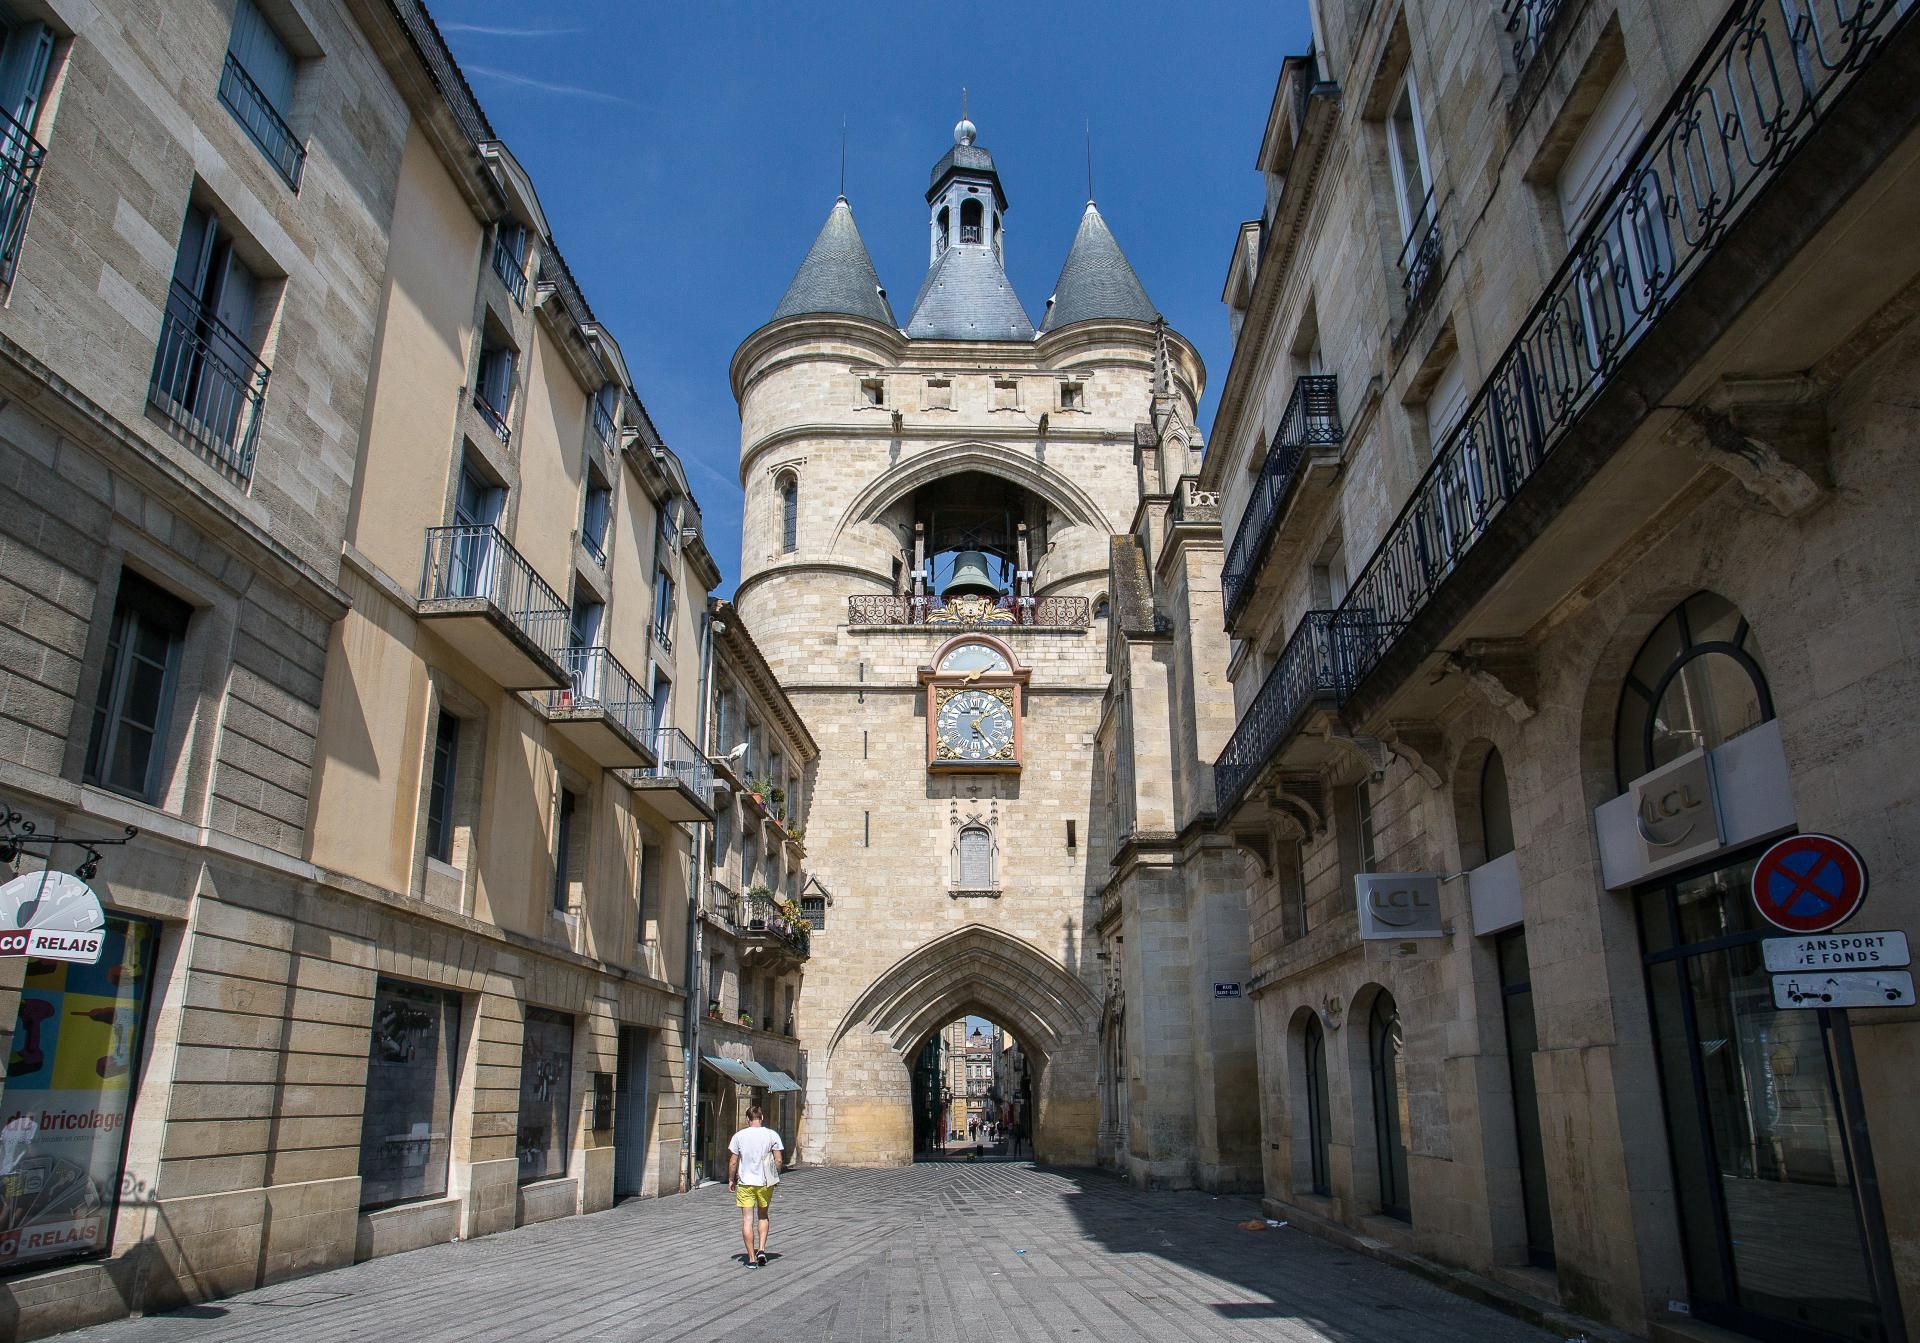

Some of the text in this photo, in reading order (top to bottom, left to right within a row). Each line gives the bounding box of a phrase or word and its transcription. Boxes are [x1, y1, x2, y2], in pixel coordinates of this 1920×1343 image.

[1643, 785, 1702, 824] LCL
[1374, 891, 1431, 908] LCL
[36, 937, 98, 953] RELAIS
[1798, 937, 1885, 951] ANSPORT
[1800, 951, 1879, 965] E FONDS
[40, 1110, 124, 1132] bricolage
[27, 1225, 97, 1248] RELAIS
